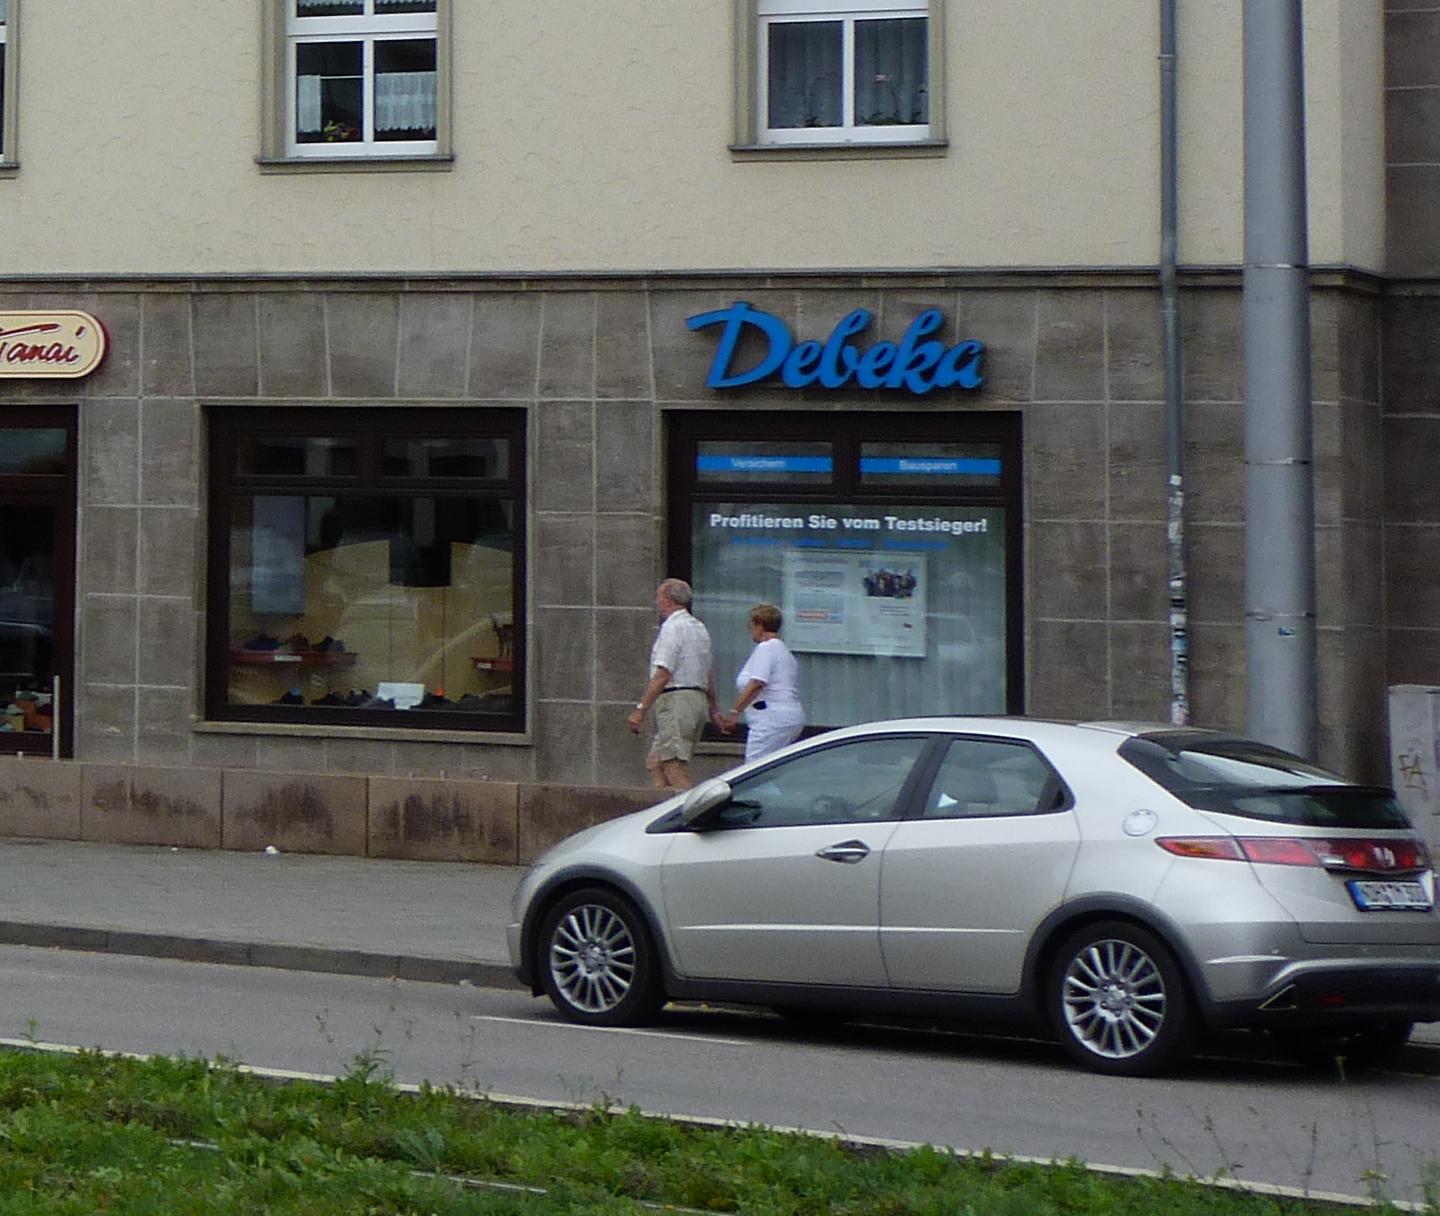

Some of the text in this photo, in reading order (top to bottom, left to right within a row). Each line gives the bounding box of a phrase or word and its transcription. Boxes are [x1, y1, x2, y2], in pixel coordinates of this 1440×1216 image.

[684, 300, 986, 394] Debeka
[709, 513, 988, 535] Profitieren Sie vom Testsieger!
